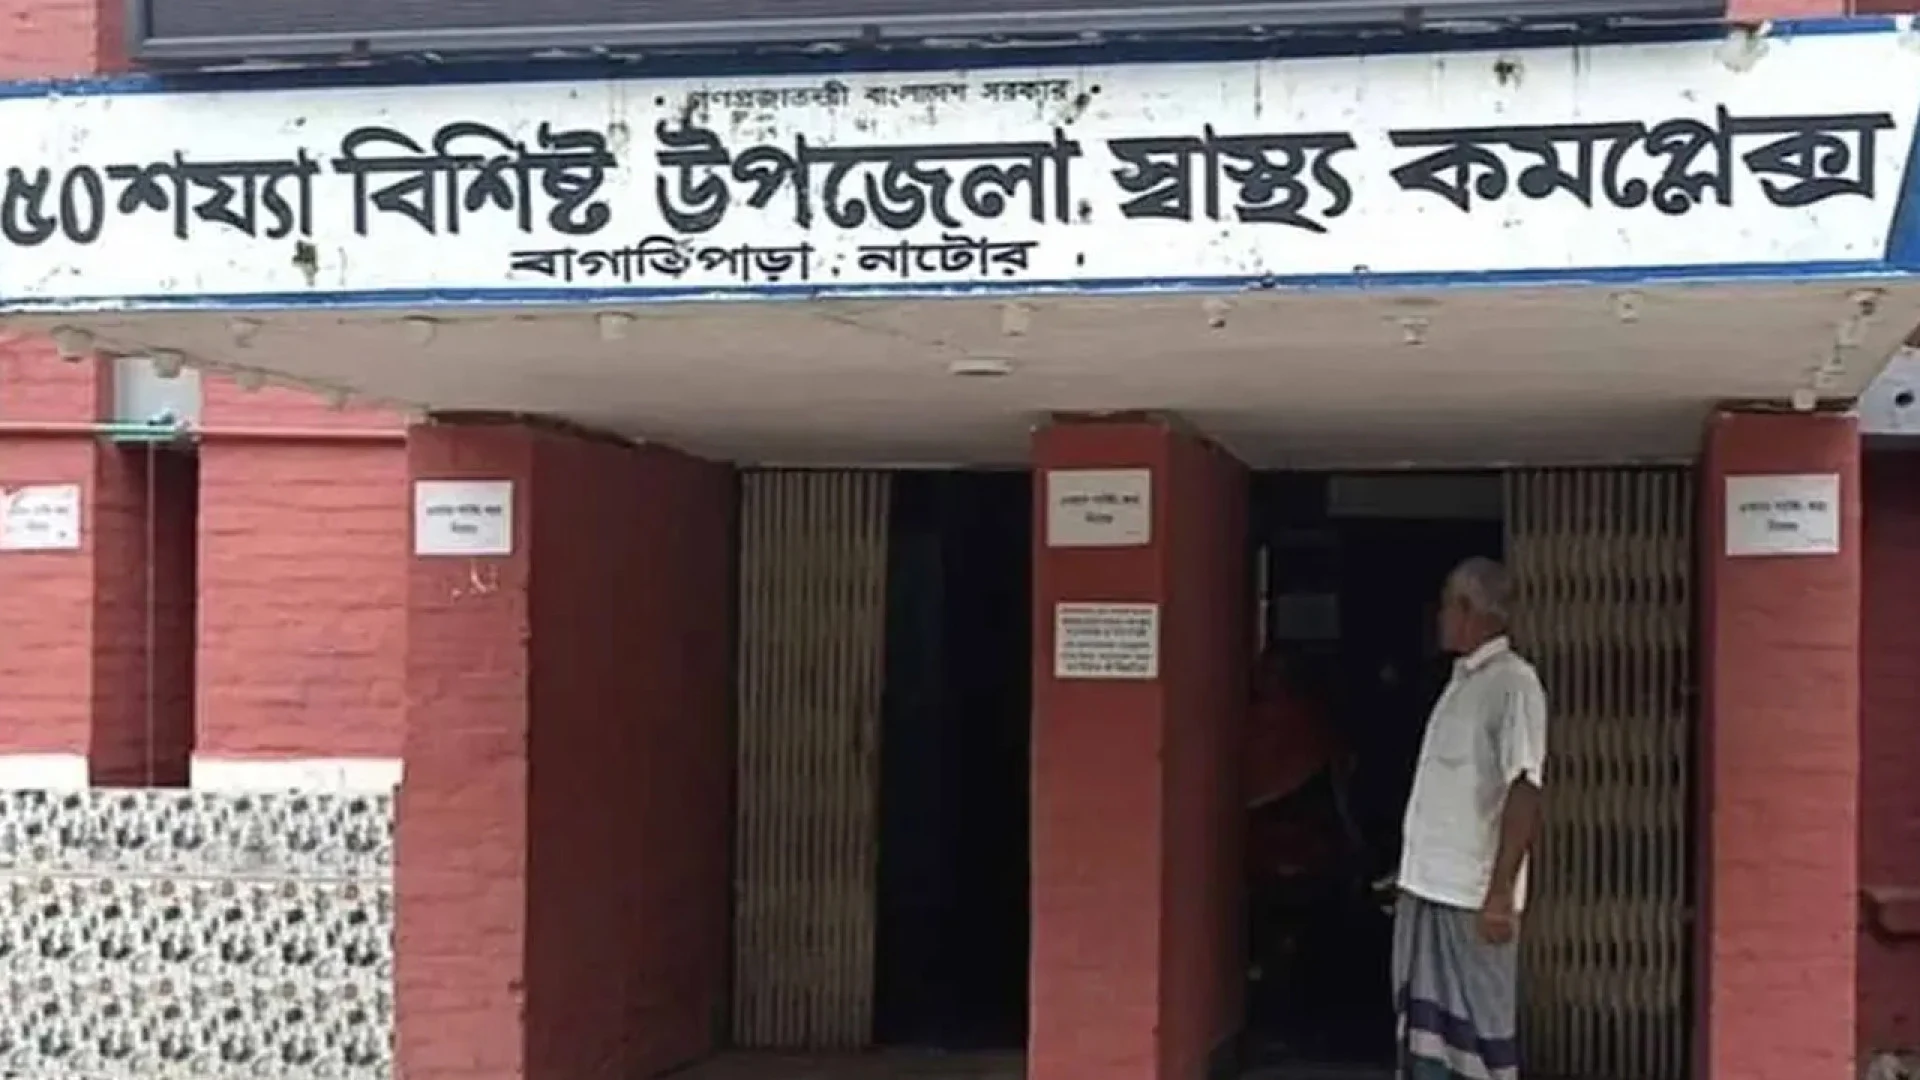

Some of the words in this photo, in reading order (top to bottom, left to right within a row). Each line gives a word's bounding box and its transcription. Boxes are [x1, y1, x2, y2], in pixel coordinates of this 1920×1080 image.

[981, 79, 1073, 102] সরকার
[331, 122, 618, 235] বিশিষ্ট
[655, 118, 1083, 234] উপজেলা
[1107, 123, 1357, 233] স্বাস্থ্য
[1388, 104, 1896, 216] কমপ্লেক্স
